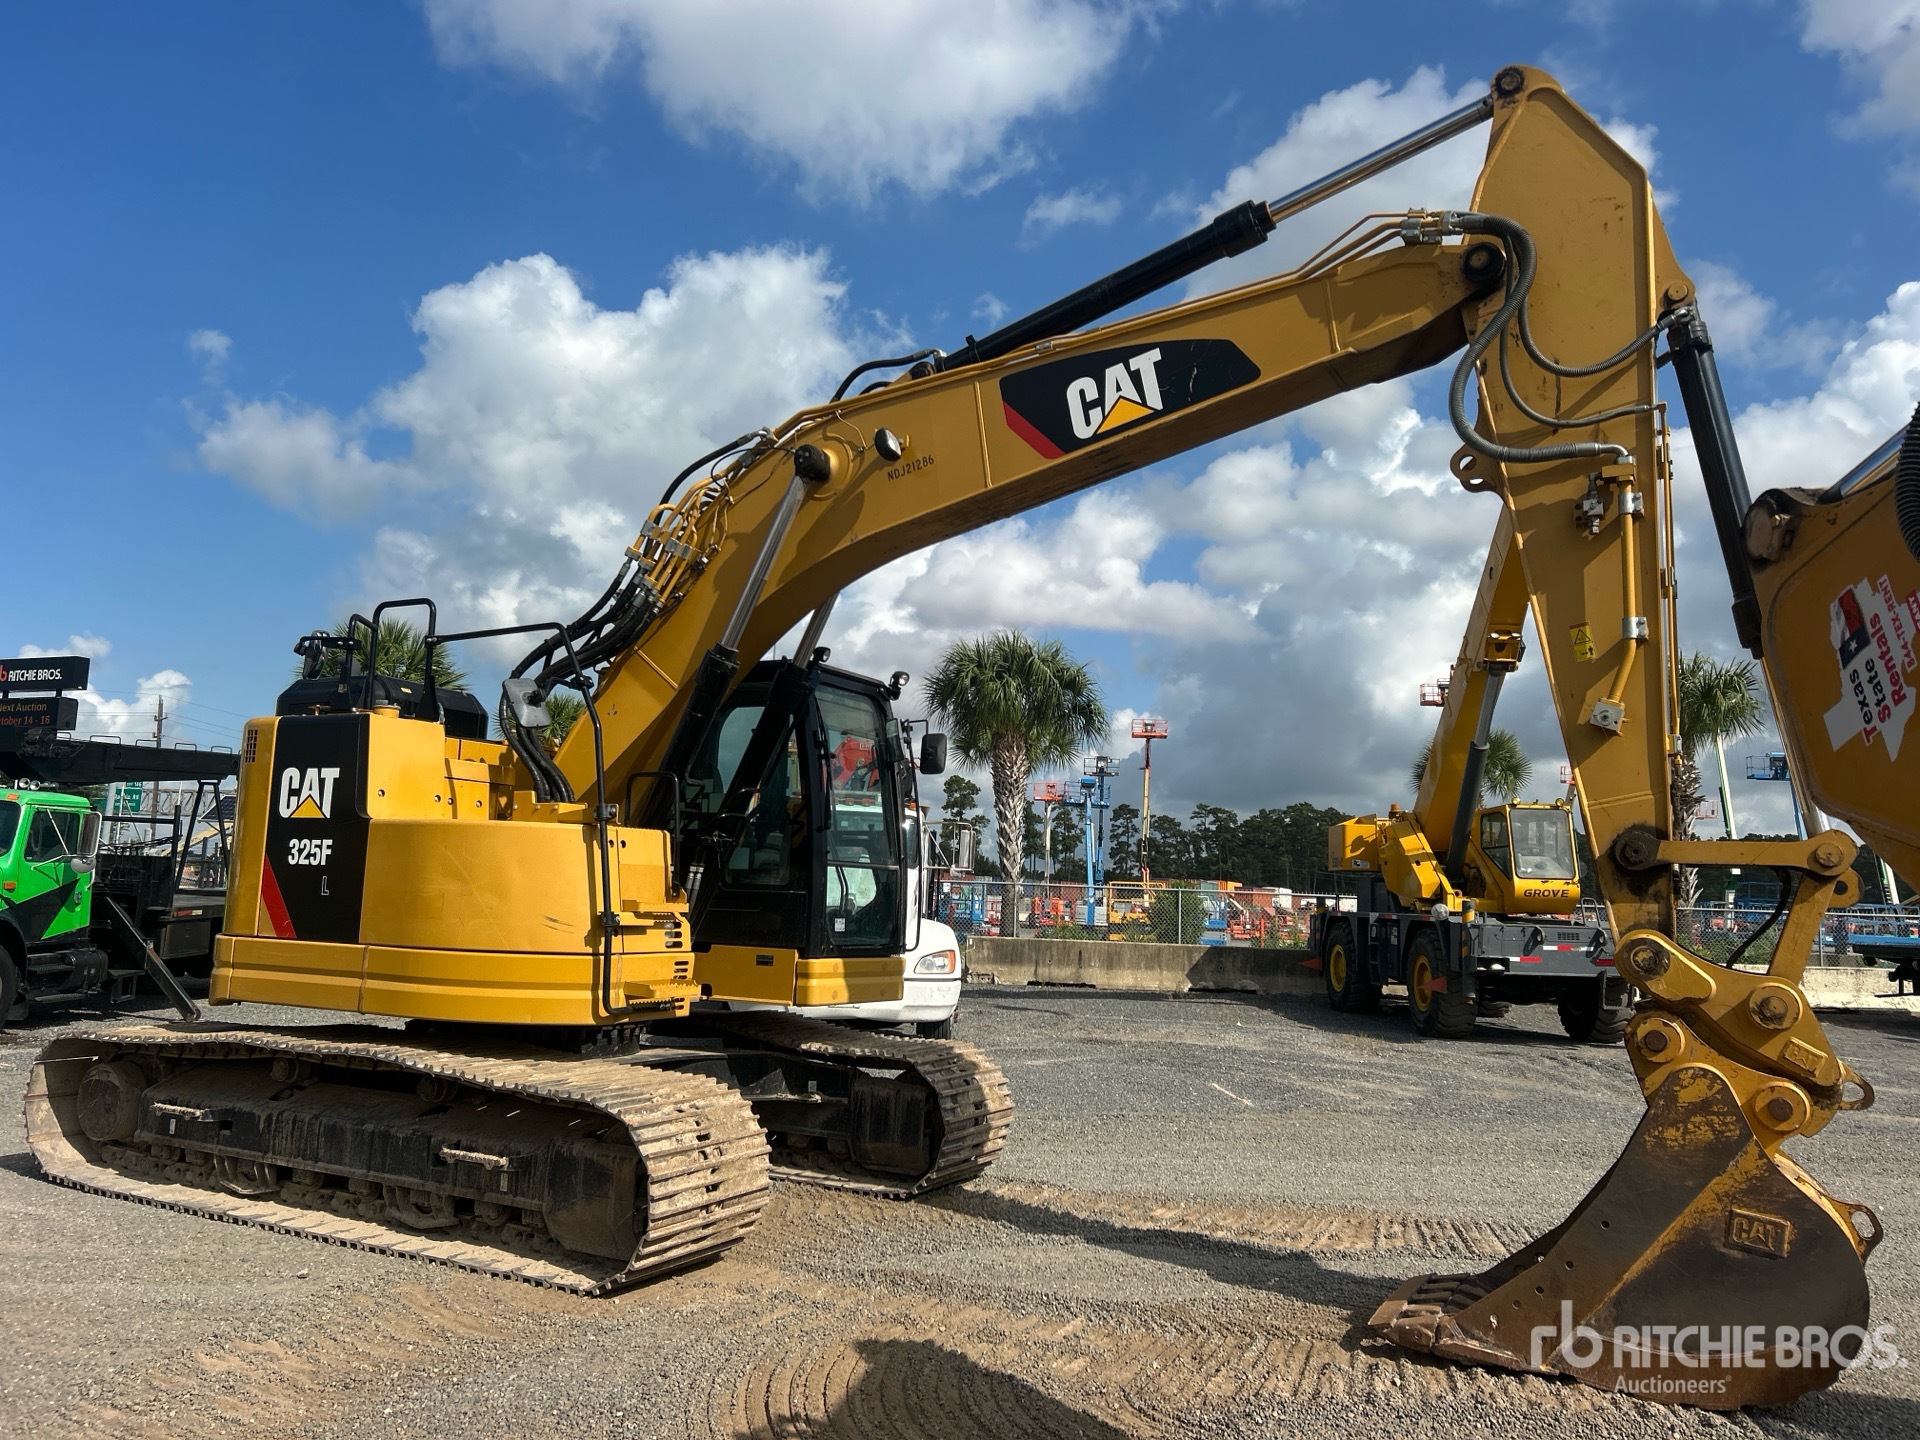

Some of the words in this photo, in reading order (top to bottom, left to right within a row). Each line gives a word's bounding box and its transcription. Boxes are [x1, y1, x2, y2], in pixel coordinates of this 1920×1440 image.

[1066, 347, 1163, 439] CAT
[888, 455, 935, 482] NDJ21286
[1878, 577, 1915, 669] 844-TEX-RENT
[8, 670, 37, 682] RITCHIE
[37, 668, 63, 680] BROS.
[1870, 613, 1907, 707] Rentals
[1865, 658, 1891, 723] State
[0, 715, 23, 726] tober
[16, 703, 47, 711] Auction
[1850, 669, 1877, 744] Texas
[279, 767, 340, 818] CAT
[288, 838, 333, 866] 325F
[321, 875, 330, 896] L
[1524, 889, 1570, 898] GROVE
[1785, 1042, 1819, 1072] CAT
[1733, 1217, 1777, 1251] CAT
